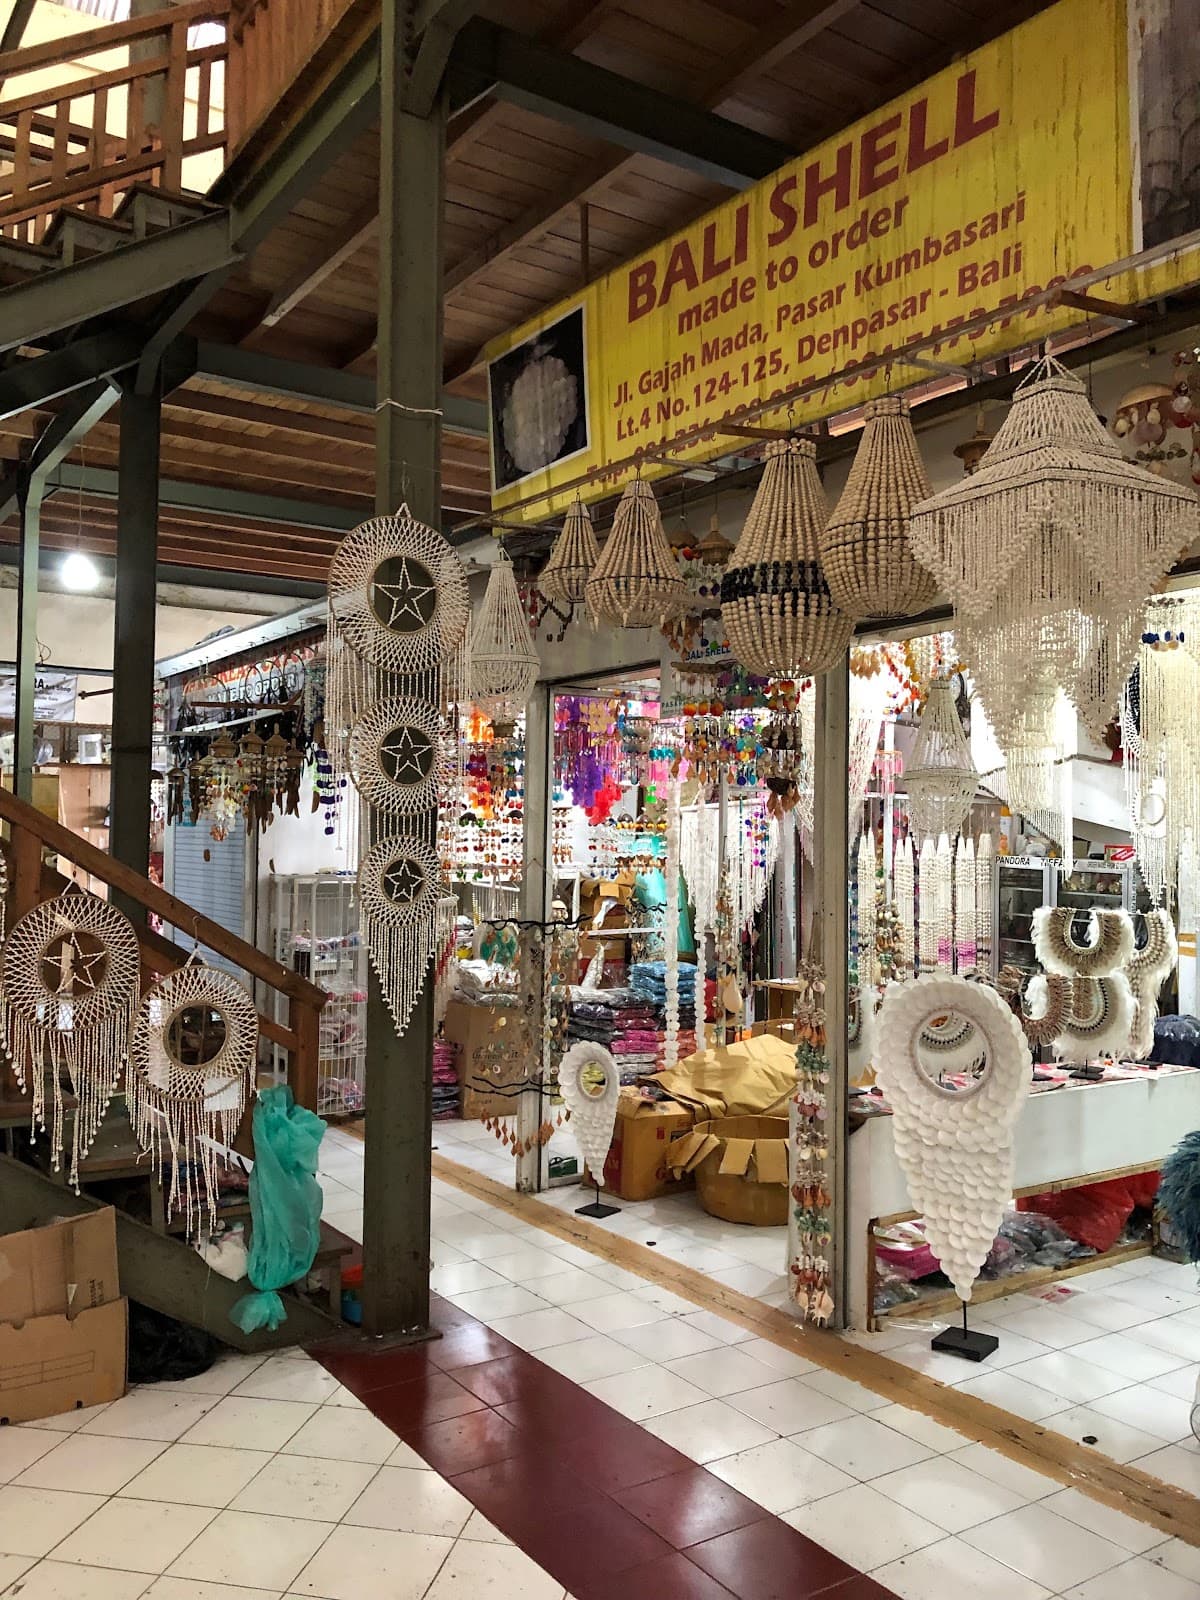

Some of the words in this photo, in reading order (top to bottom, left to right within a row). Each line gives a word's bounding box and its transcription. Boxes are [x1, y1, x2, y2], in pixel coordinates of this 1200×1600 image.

[628, 203, 749, 323] BALI
[768, 69, 1000, 247] SHELL
[678, 264, 756, 336] made
[766, 255, 799, 291] to
[808, 196, 910, 269] order
[613, 381, 633, 408] Jl.
[638, 352, 696, 395] Gajah
[701, 322, 768, 367] Mada,
[776, 282, 847, 332] Pasar
[854, 191, 1026, 297] Kumbasari
[798, 288, 931, 364] Denpasar
[958, 243, 1022, 297] Bali
[995, 855, 1030, 866] PANDORA
[1040, 858, 1077, 868] TIFFAY
